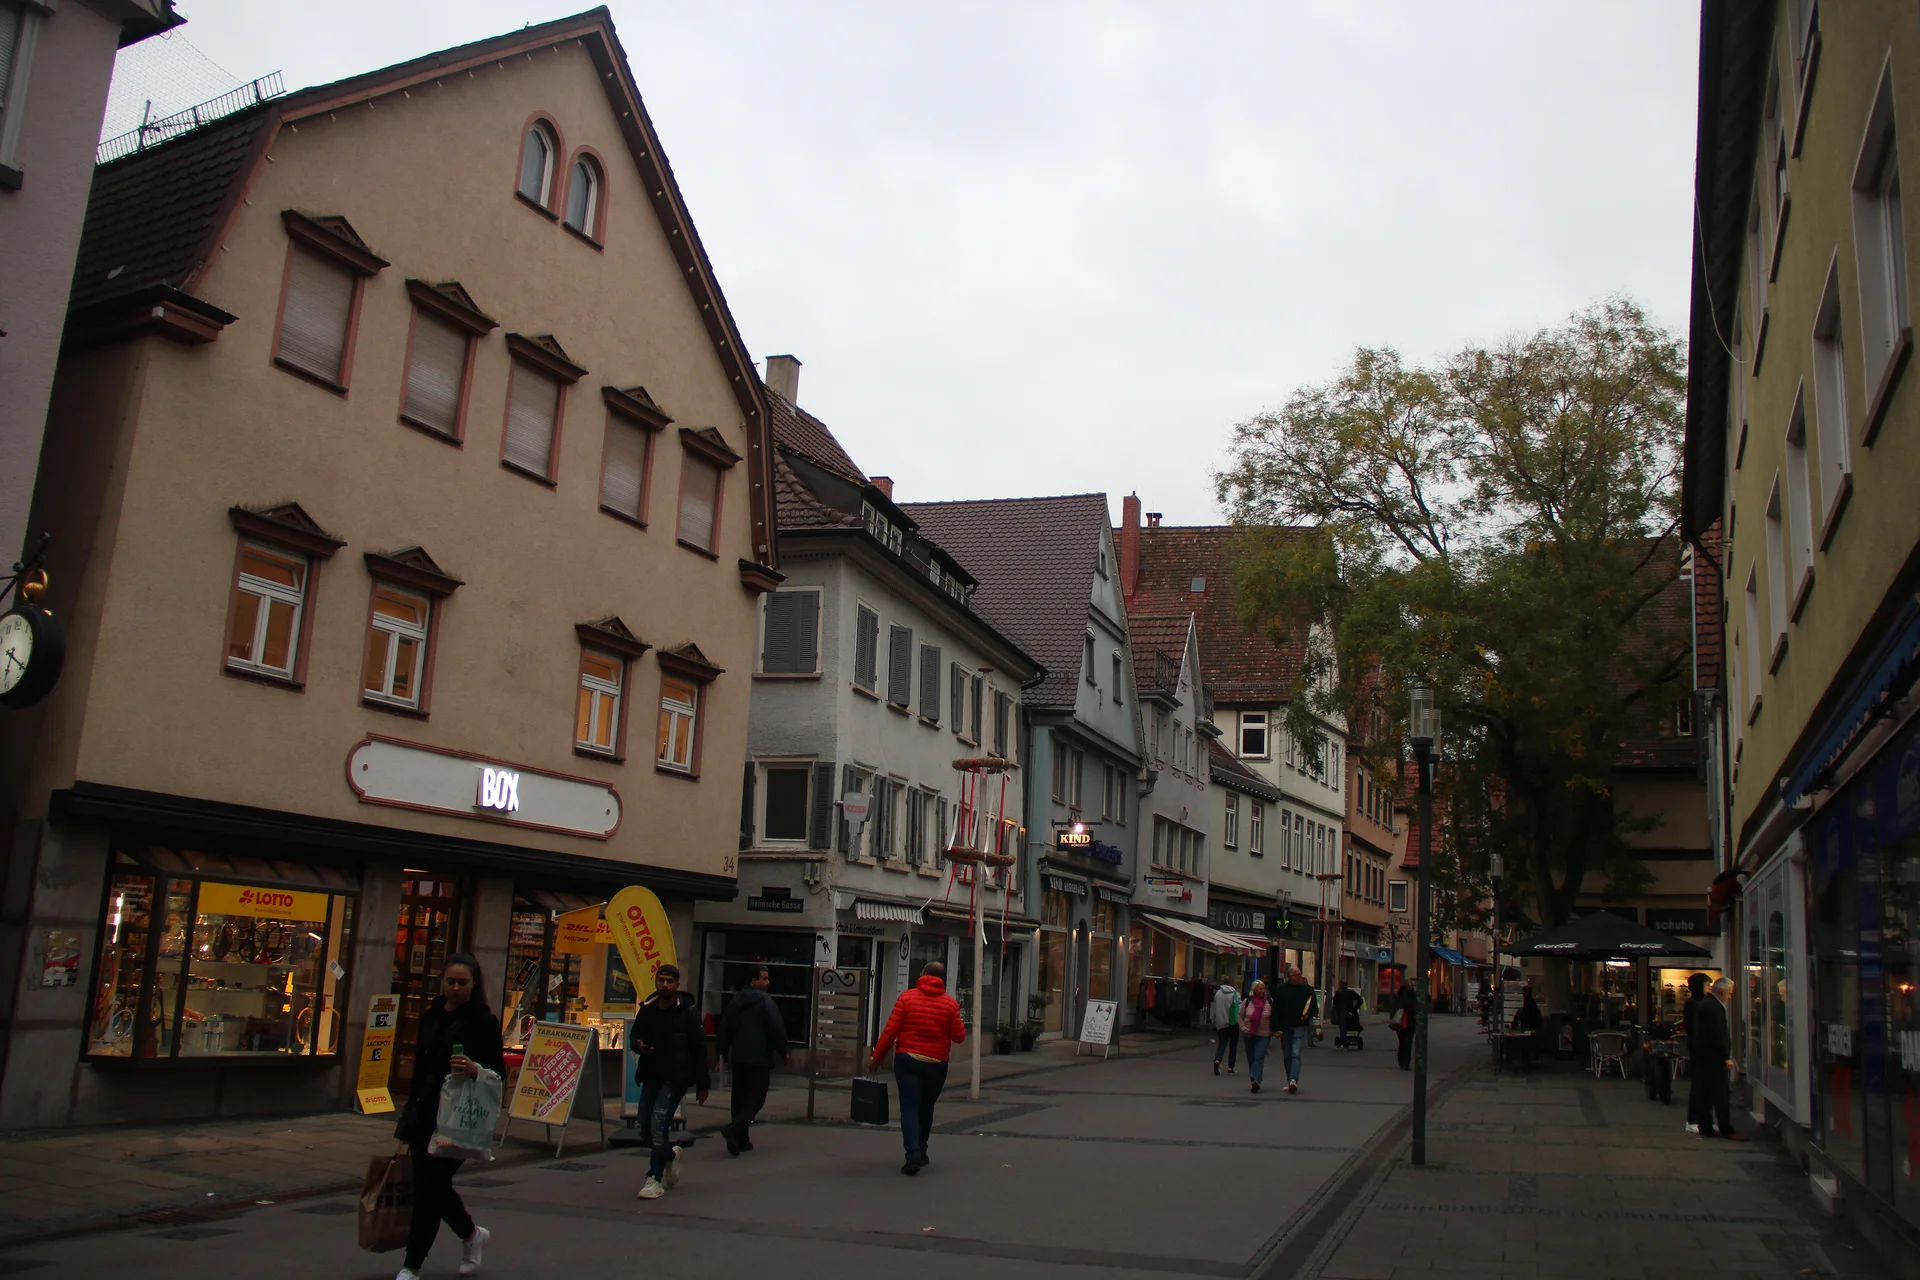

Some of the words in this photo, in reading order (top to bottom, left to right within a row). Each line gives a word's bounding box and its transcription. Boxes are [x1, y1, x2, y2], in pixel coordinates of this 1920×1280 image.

[483, 768, 519, 811] BOX
[1060, 834, 1091, 844] KIND
[724, 856, 734, 873] 34
[256, 892, 293, 907] LOTTO
[781, 901, 801, 910] Gasse
[567, 924, 590, 932] DHL
[1656, 919, 1695, 931] schuhe
[538, 1028, 586, 1041] TABAKWAREN
[543, 1049, 566, 1075] JEDES
[551, 1058, 570, 1078] BIER
[554, 1079, 561, 1087] 2
[561, 1064, 576, 1079] EUR
[540, 1079, 576, 1116] EISCREME
